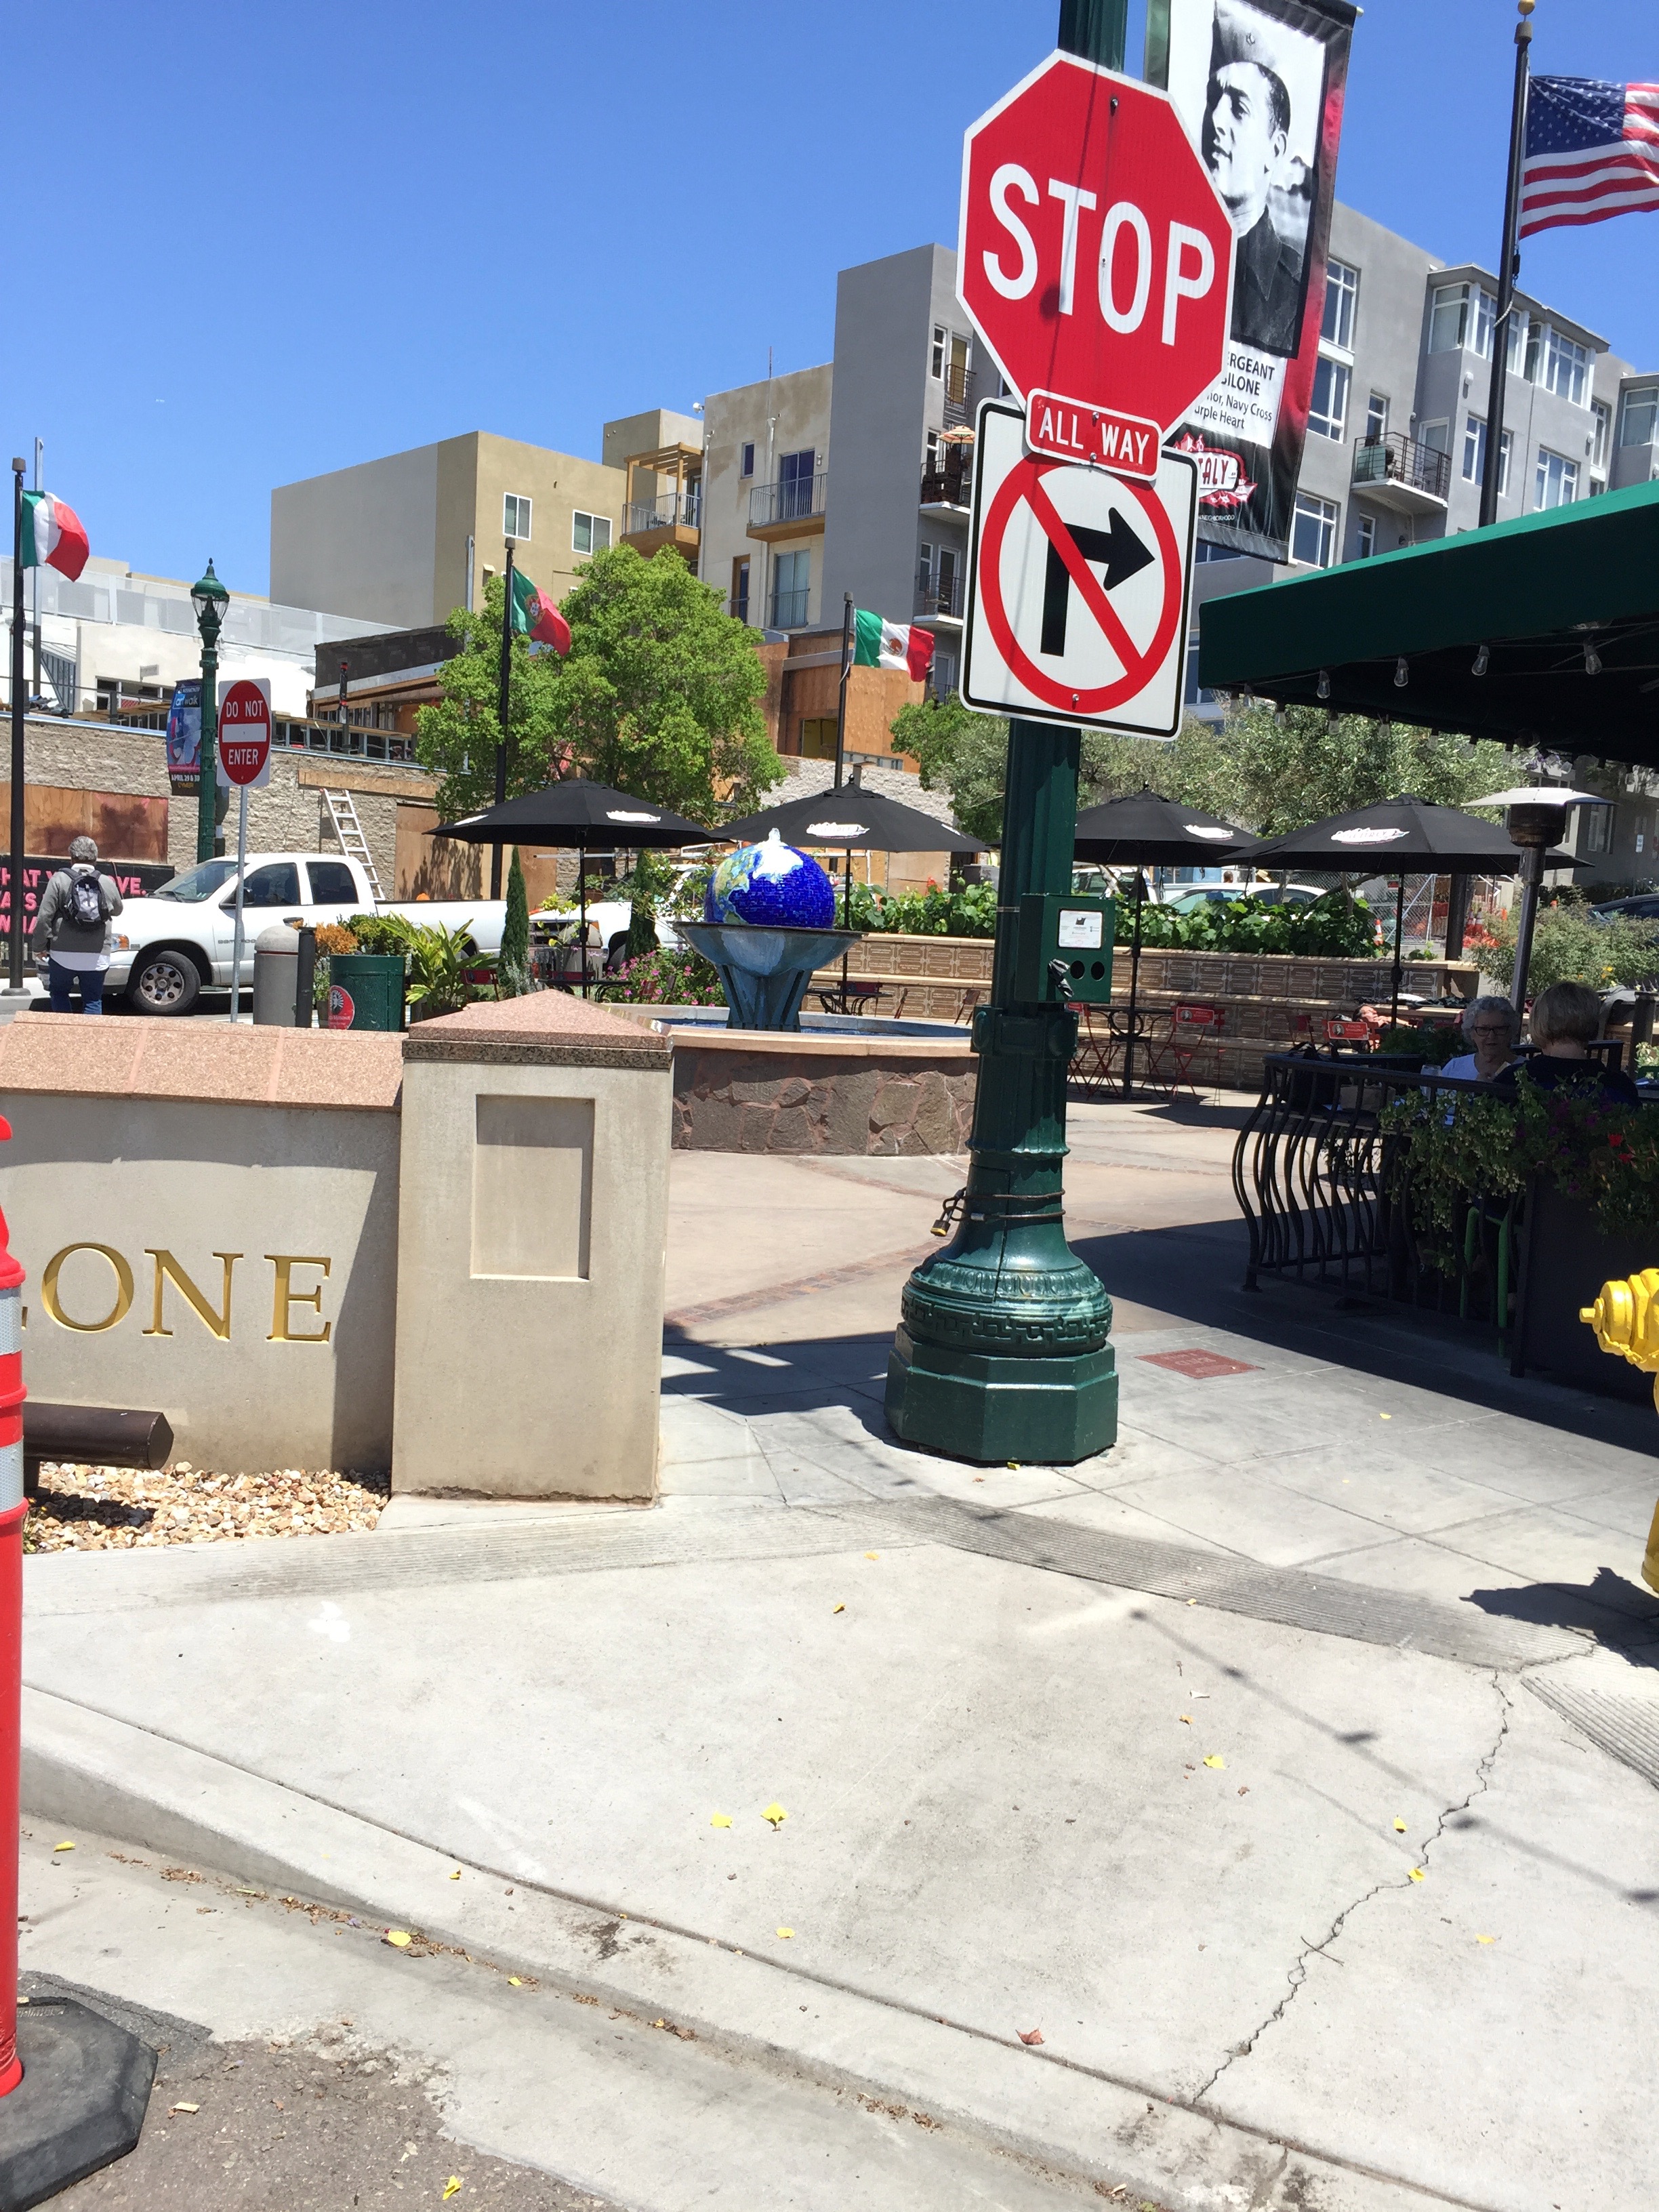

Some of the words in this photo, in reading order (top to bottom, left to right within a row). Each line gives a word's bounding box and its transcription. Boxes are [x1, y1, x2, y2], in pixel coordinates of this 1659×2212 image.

[983, 163, 1215, 346] STOP
[1227, 351, 1275, 380] RGEANT
[1220, 409, 1245, 428] Heart
[1226, 394, 1249, 415] Navy
[1250, 403, 1272, 422] Cross
[1038, 407, 1084, 449] ALL
[1101, 423, 1150, 465] WAY
[226, 701, 238, 718] DO
[245, 700, 263, 717] NOT
[228, 749, 259, 766] ENTER
[22, 1242, 332, 1345] ONE
